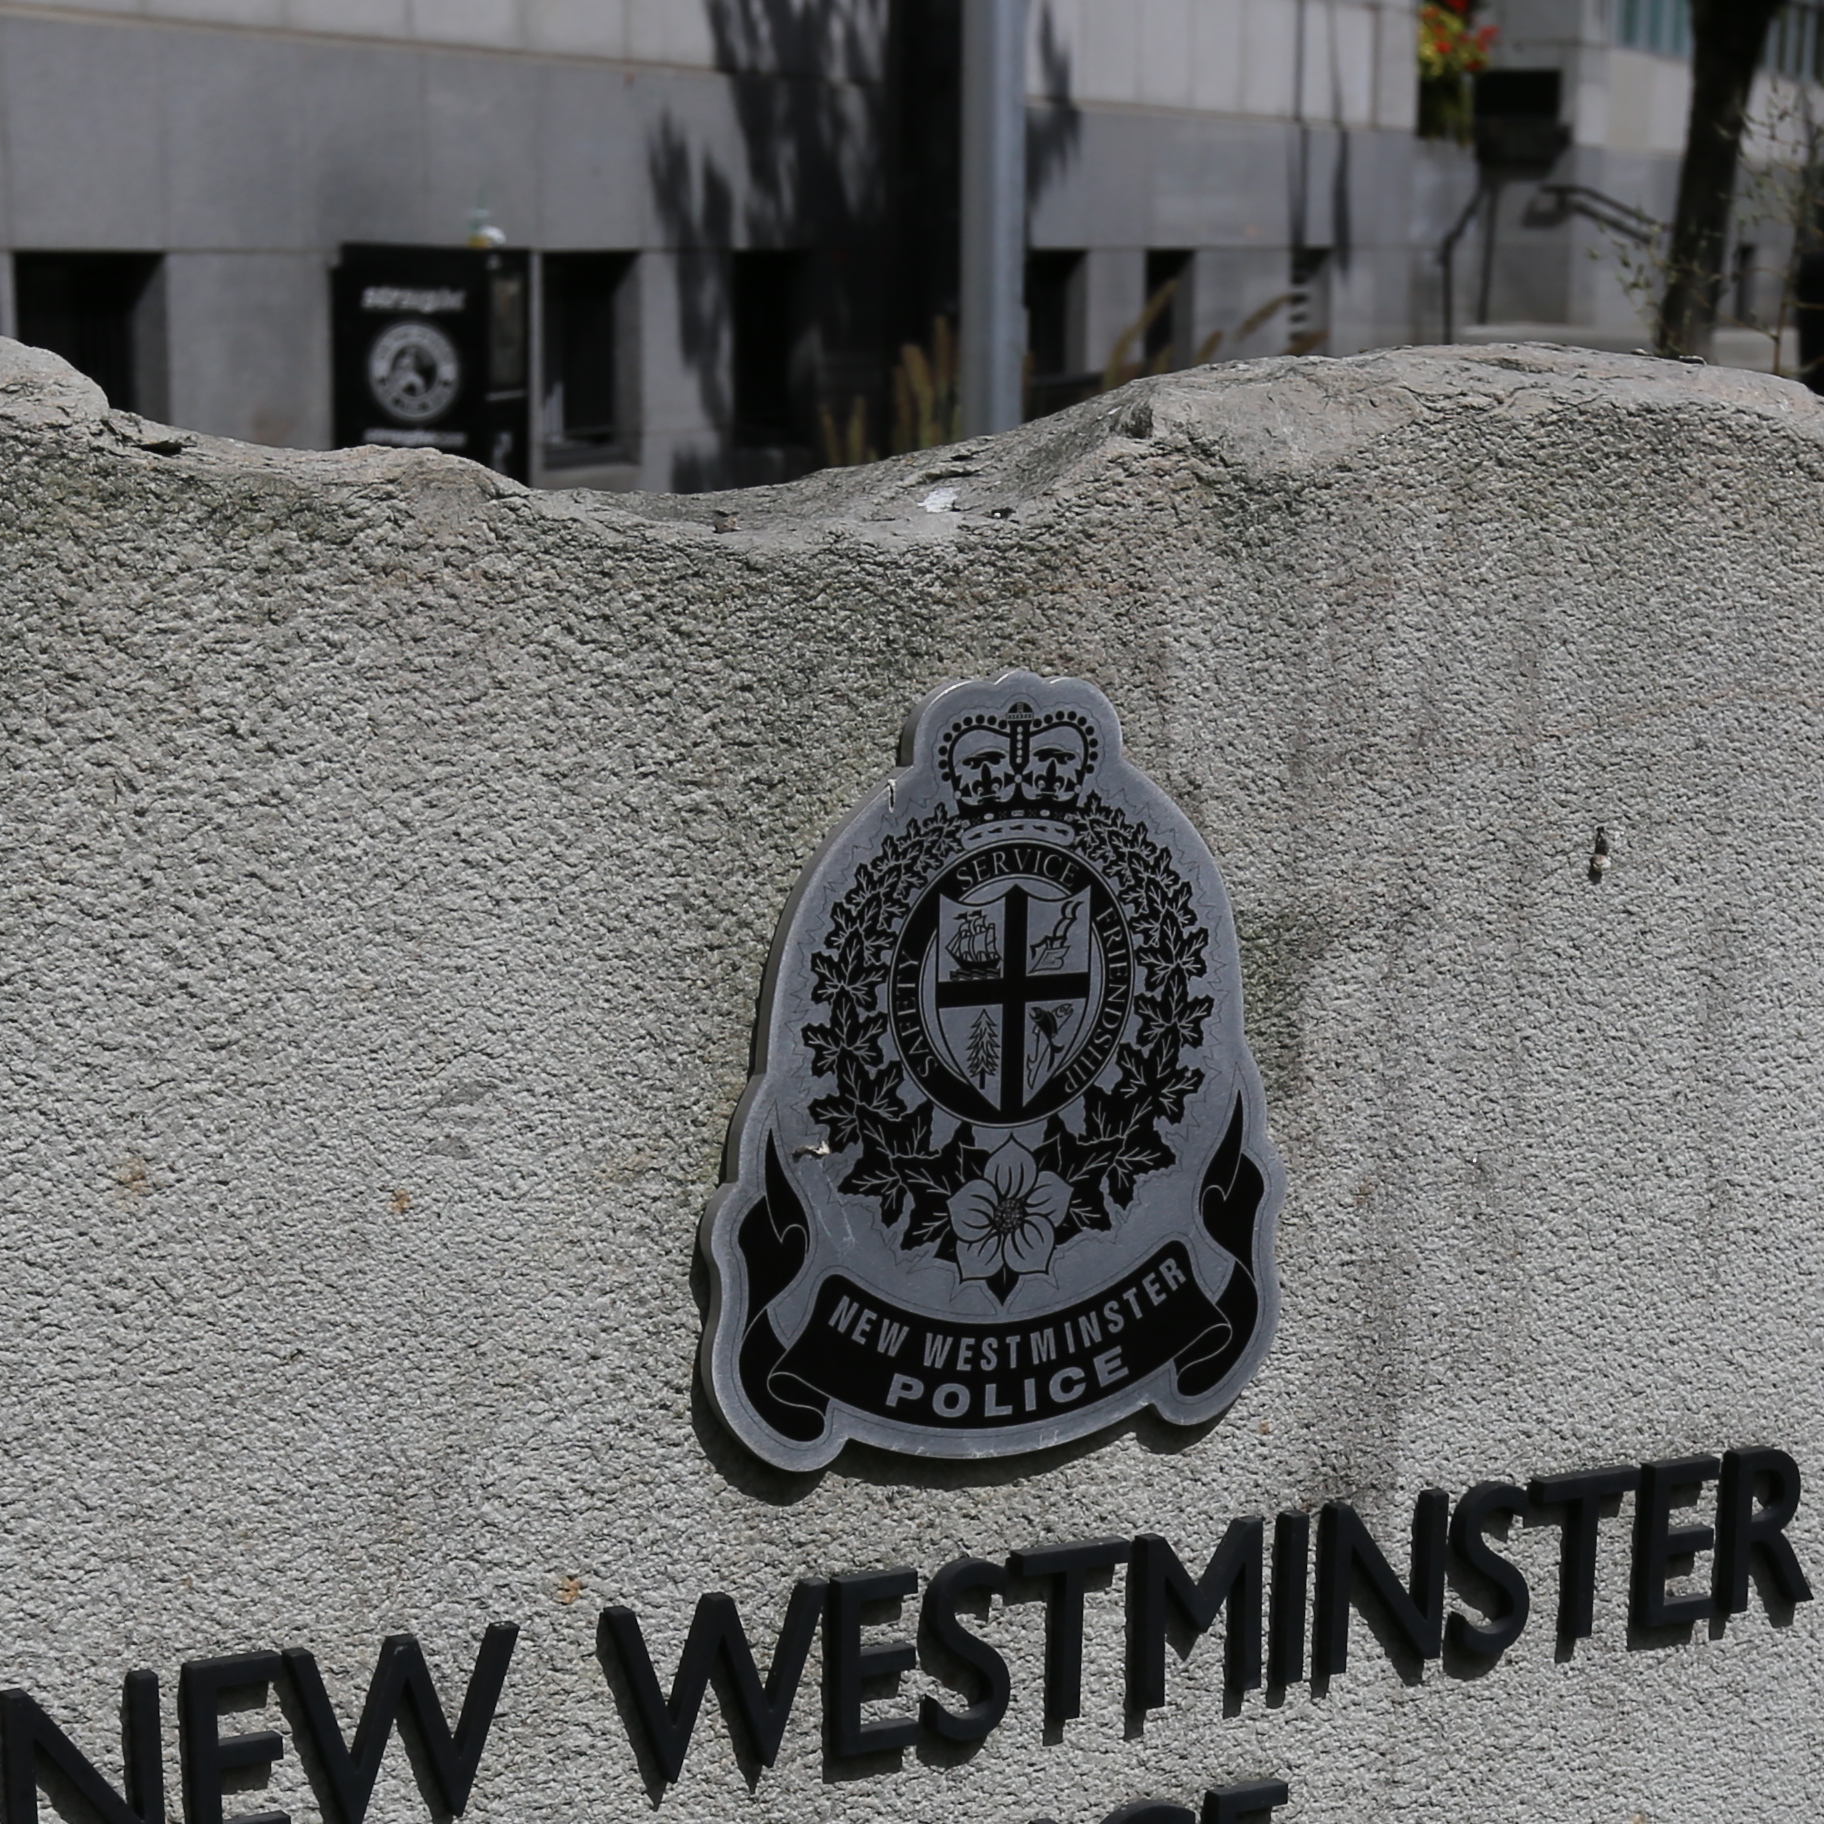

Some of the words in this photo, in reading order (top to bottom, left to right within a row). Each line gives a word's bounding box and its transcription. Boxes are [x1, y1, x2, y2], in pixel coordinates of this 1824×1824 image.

[956, 849, 1079, 891] SERVICE
[895, 951, 939, 1078] SAFETY
[1063, 907, 1129, 1094] FRIENDSHIP
[828, 1295, 910, 1358] NEW
[923, 1257, 1187, 1371] WESTMINSTER
[885, 1345, 1130, 1418] POLICE
[599, 1446, 1813, 1783] WESTMINSTER
